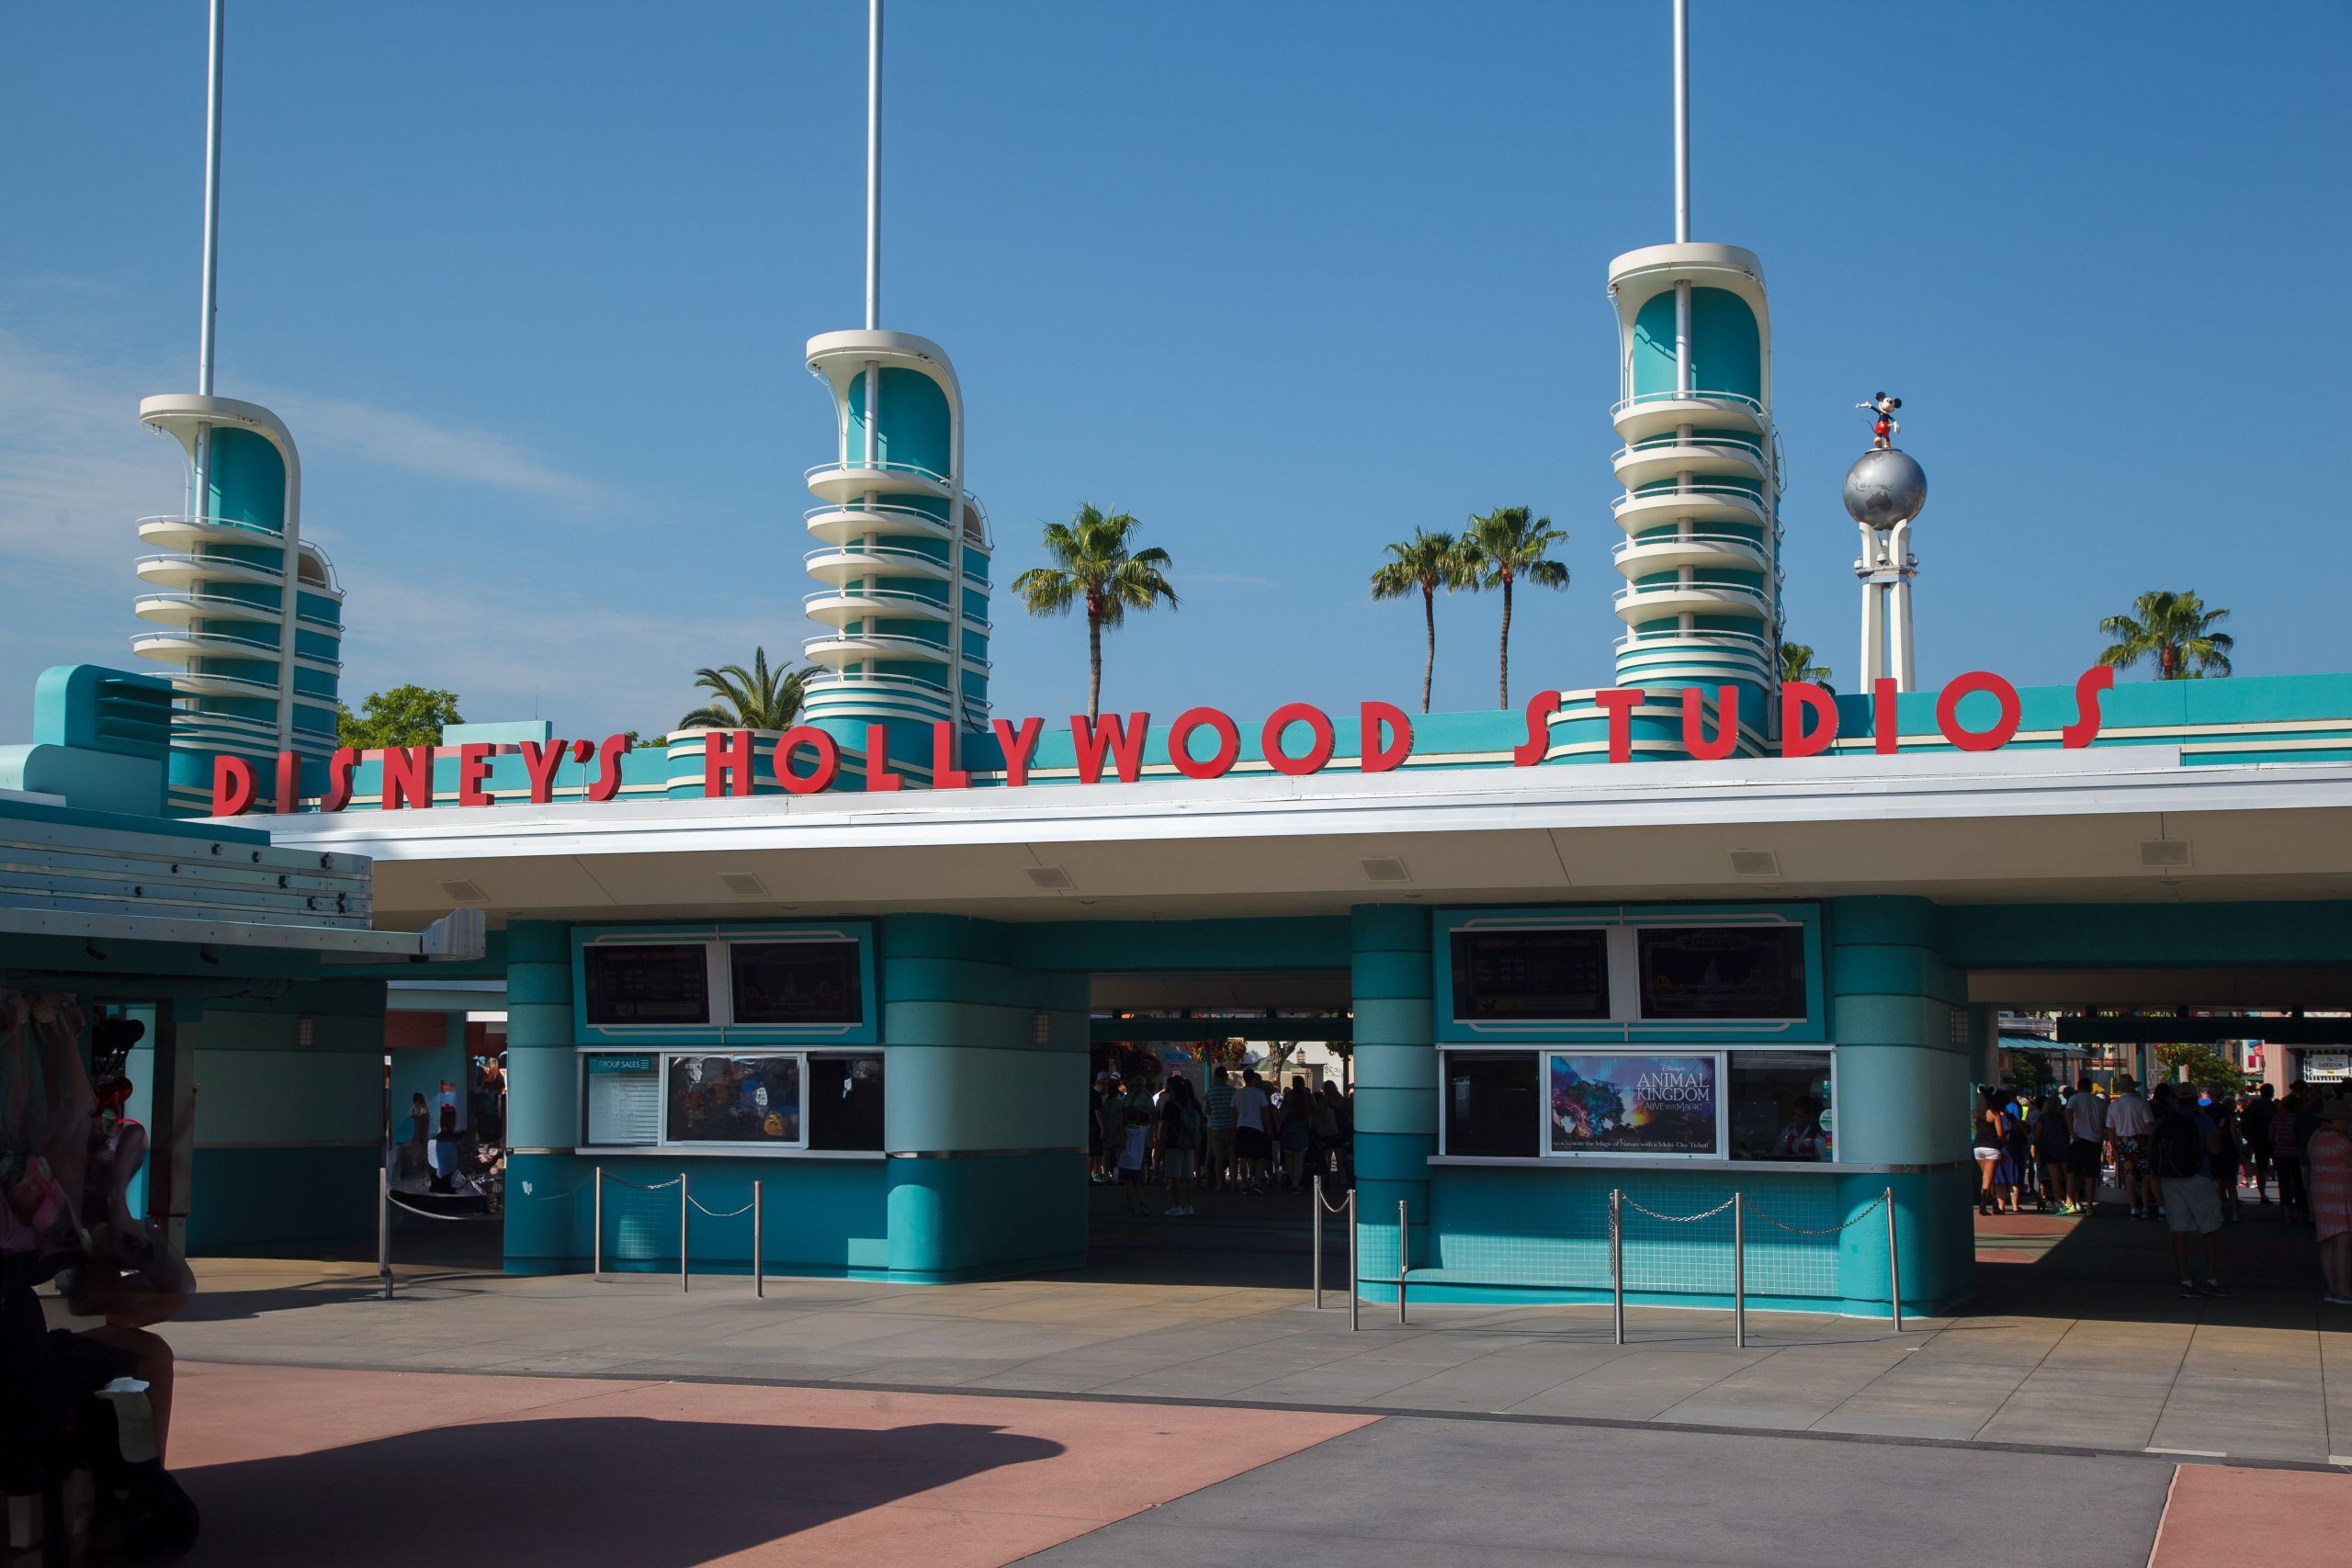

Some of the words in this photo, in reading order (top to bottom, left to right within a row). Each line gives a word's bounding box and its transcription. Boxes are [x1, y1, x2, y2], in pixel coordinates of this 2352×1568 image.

[211, 732, 632, 817] DISNEY'S
[705, 701, 1415, 797] HOLLYWOOD
[1514, 665, 2113, 766] STUDIOS
[621, 1060, 640, 1068] SALES
[1636, 1072, 1710, 1088] ANIMAL
[1636, 1087, 1710, 1101] KINGDOM
[1645, 1102, 1665, 1111] ALIVE
[1676, 1102, 1703, 1111] MAGIC
